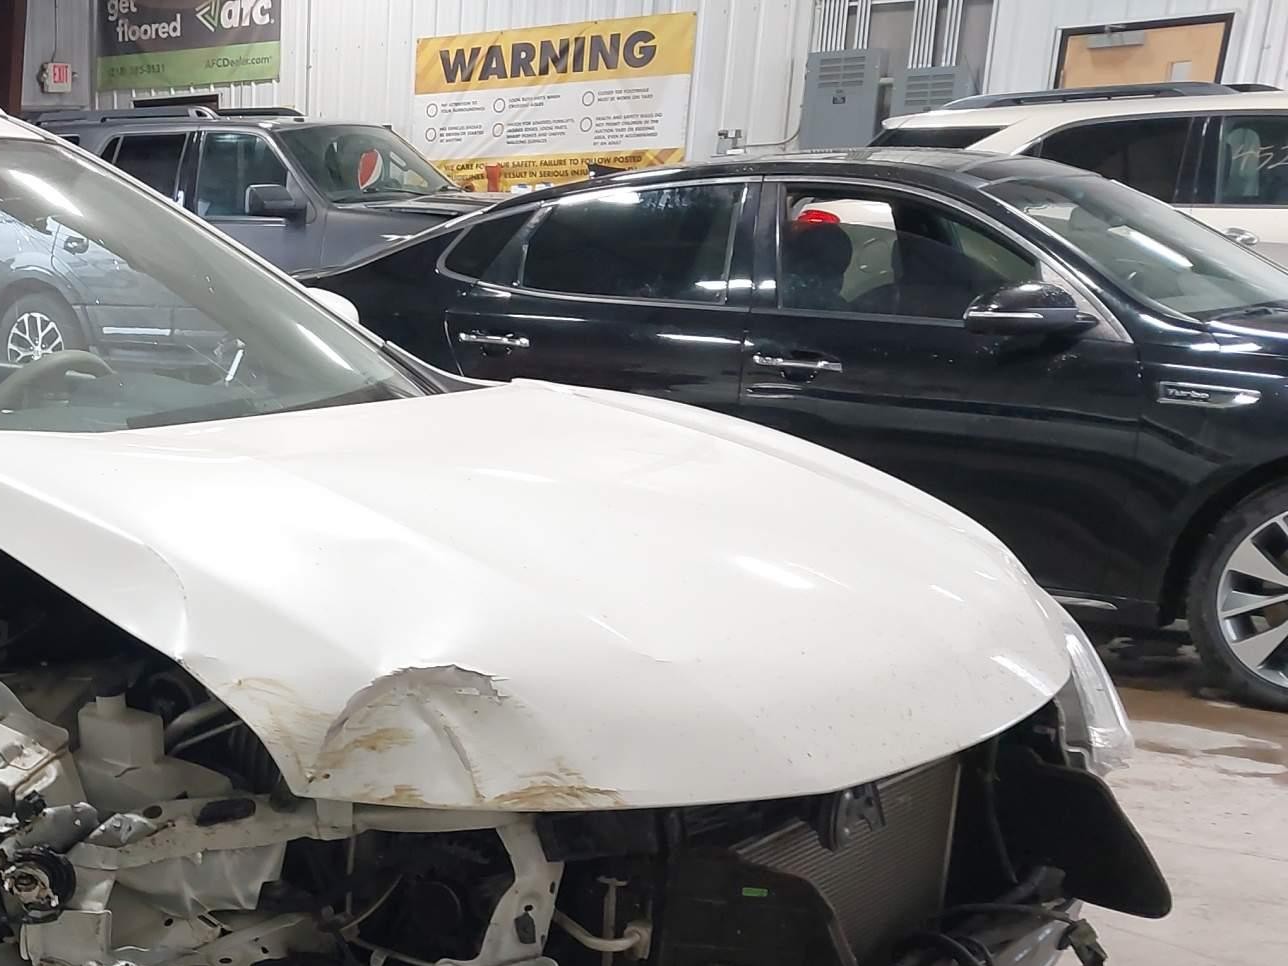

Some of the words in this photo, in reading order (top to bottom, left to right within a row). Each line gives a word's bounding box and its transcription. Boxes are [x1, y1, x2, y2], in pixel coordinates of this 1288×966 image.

[116, 13, 181, 42] floored
[439, 30, 657, 83] WARNING
[53, 64, 69, 83] EXIT
[456, 163, 473, 171] CARE
[475, 162, 485, 170] FO
[540, 159, 567, 167] FAILURE
[569, 158, 579, 166] TO
[613, 155, 642, 164] POSTED
[529, 170, 537, 178] IN
[539, 169, 568, 178] SERIOUS
[570, 169, 588, 177] INJU
